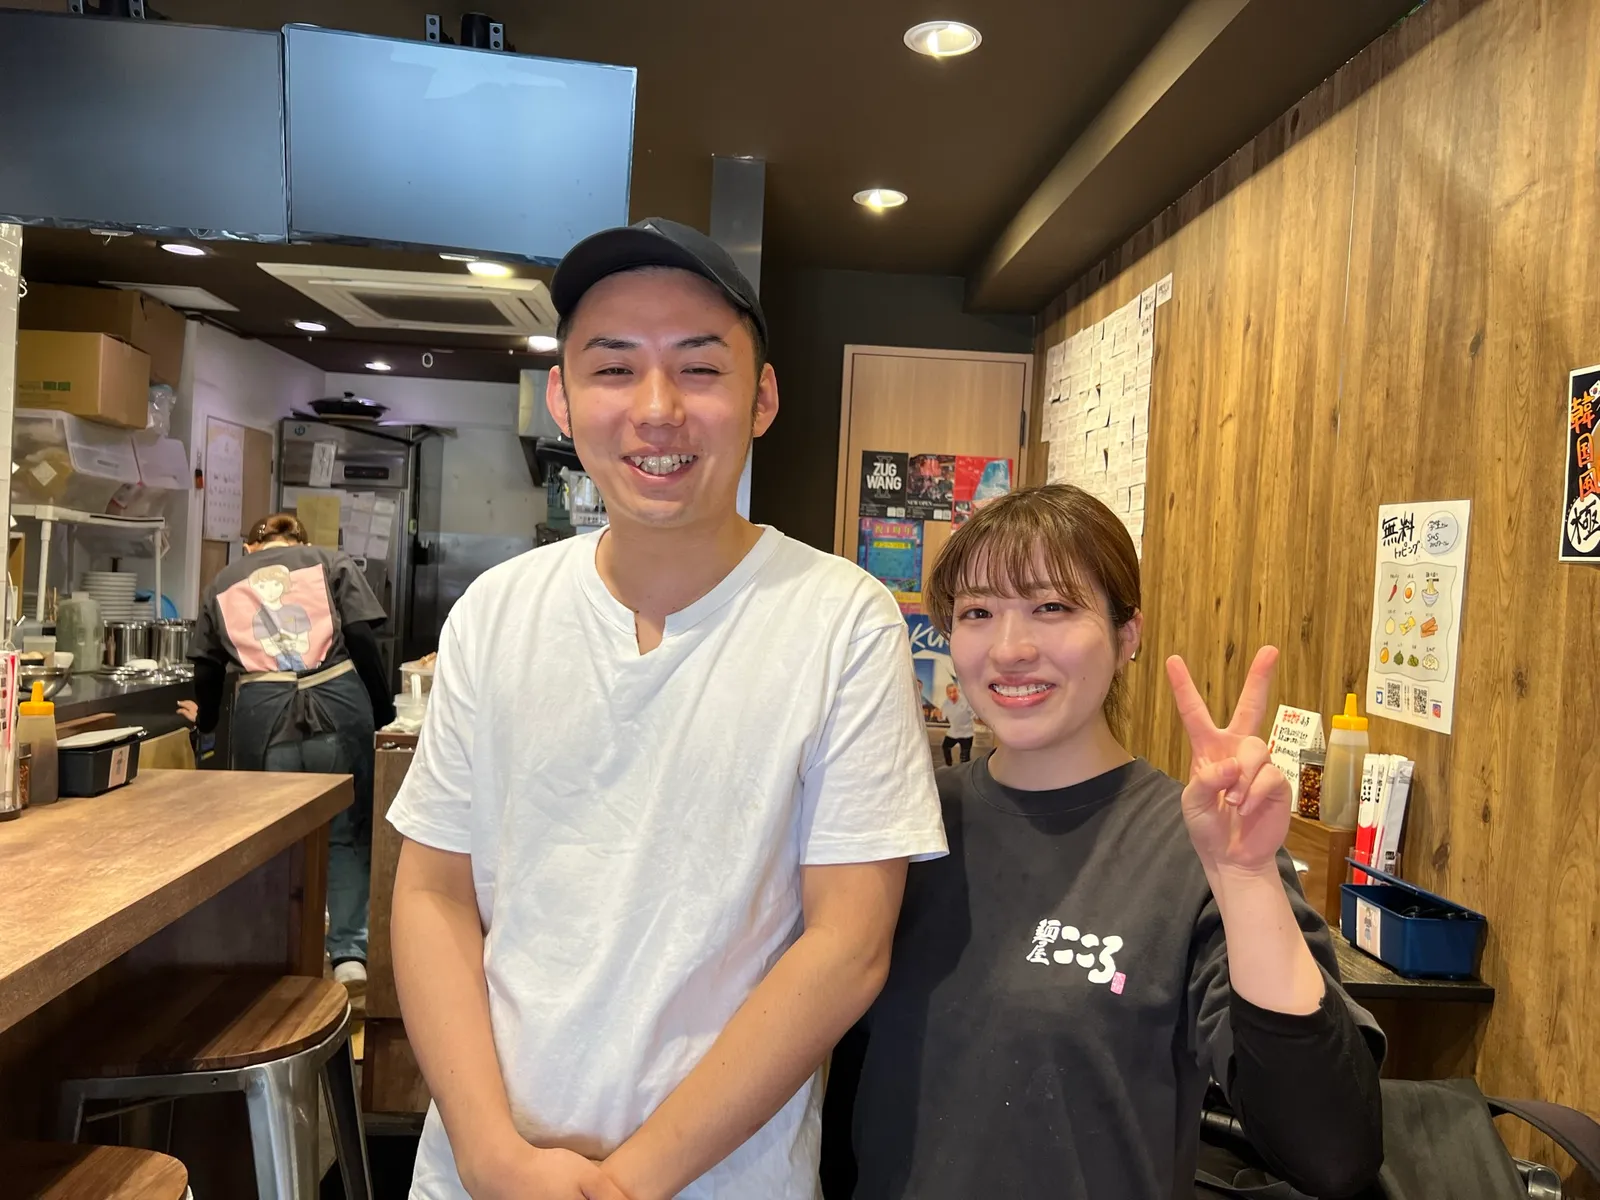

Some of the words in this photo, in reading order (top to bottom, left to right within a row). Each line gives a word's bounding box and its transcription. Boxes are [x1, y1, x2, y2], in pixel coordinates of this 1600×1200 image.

[1571, 391, 1600, 502] 韓国風
[866, 475, 902, 490] WANG
[873, 462, 897, 477] ZUG
[1382, 511, 1415, 546] 無料
[1570, 500, 1600, 545] 極
